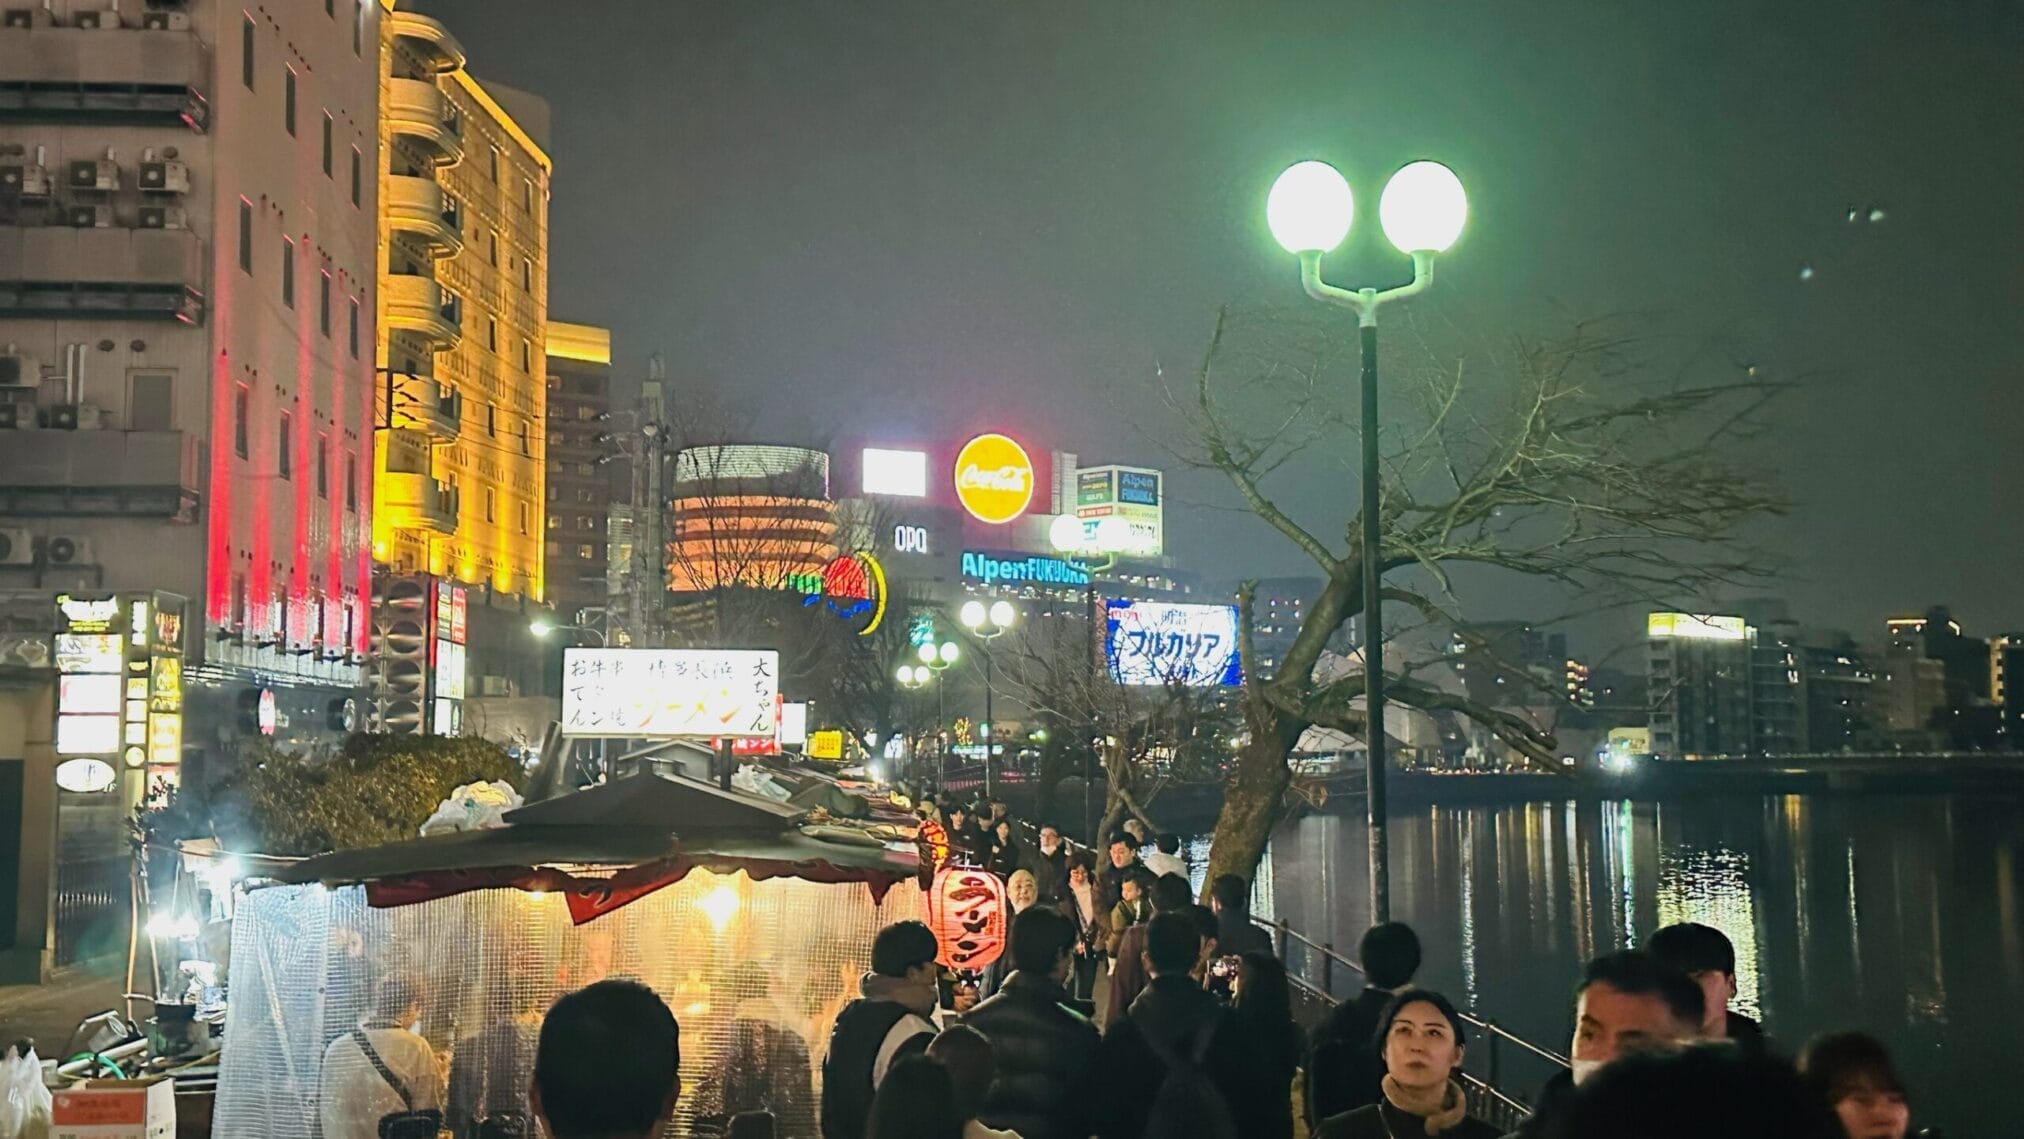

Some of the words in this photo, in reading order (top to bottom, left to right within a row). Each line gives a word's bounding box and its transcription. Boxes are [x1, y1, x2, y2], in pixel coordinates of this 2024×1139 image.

[1122, 474, 1153, 488] Alpen
[750, 657, 772, 732] 大ちゃん
